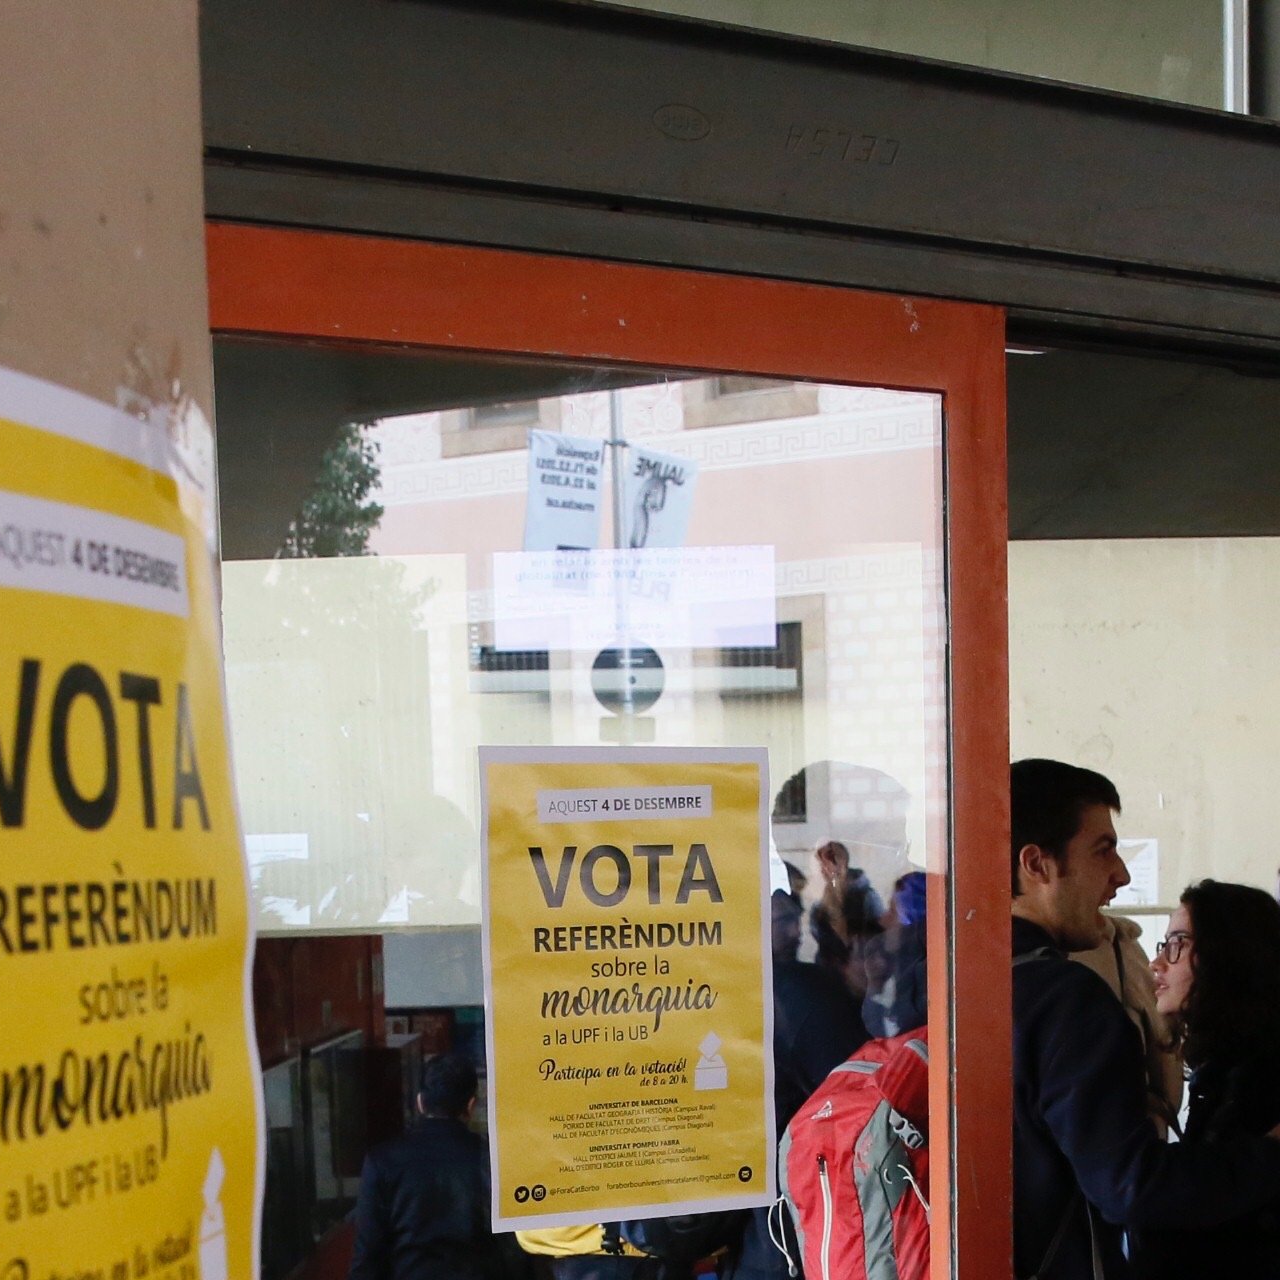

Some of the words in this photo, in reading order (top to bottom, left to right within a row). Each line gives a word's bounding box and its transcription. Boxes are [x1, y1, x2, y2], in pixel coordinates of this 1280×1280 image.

[71, 541, 83, 568] 4
[87, 540, 111, 576] DE
[114, 546, 180, 594] DESEMBRE
[548, 800, 598, 815] AQUEST
[601, 801, 609, 811] 4
[614, 799, 630, 811] DE
[634, 796, 702, 810] DESEMBRE
[528, 844, 724, 908] VOTA
[534, 918, 722, 953] REFERÈNDUM
[591, 956, 647, 978] sobre
[654, 955, 670, 975] la
[79, 968, 150, 1025] sobre
[153, 961, 170, 1010] la
[541, 979, 718, 1033] monarquia
[543, 1034, 551, 1045] a
[556, 1030, 567, 1044] la
[572, 1028, 600, 1044] UPF
[612, 1026, 624, 1042] la
[629, 1025, 648, 1041] UB
[539, 1058, 601, 1086] Participa
[606, 1066, 620, 1078] en
[624, 1062, 636, 1076] la
[641, 1057, 687, 1075] votació!
[639, 1076, 651, 1087] de
[653, 1076, 658, 1086] 8
[660, 1078, 667, 1086] a
[669, 1075, 679, 1085] 20
[589, 1101, 629, 1110] UNIVERSITAT
[641, 1098, 678, 1107] BARCELONA
[579, 1129, 608, 1137] FACULTAT
[596, 1119, 625, 1127] FACULTAT
[589, 1143, 630, 1152] UNIVERSITAT
[633, 1141, 658, 1149] POMPEU
[560, 1165, 574, 1173] HALL
[5, 1184, 20, 1222] a
[25, 1170, 49, 1214] la
[53, 1158, 98, 1209] UPF
[114, 1153, 132, 1193] la
